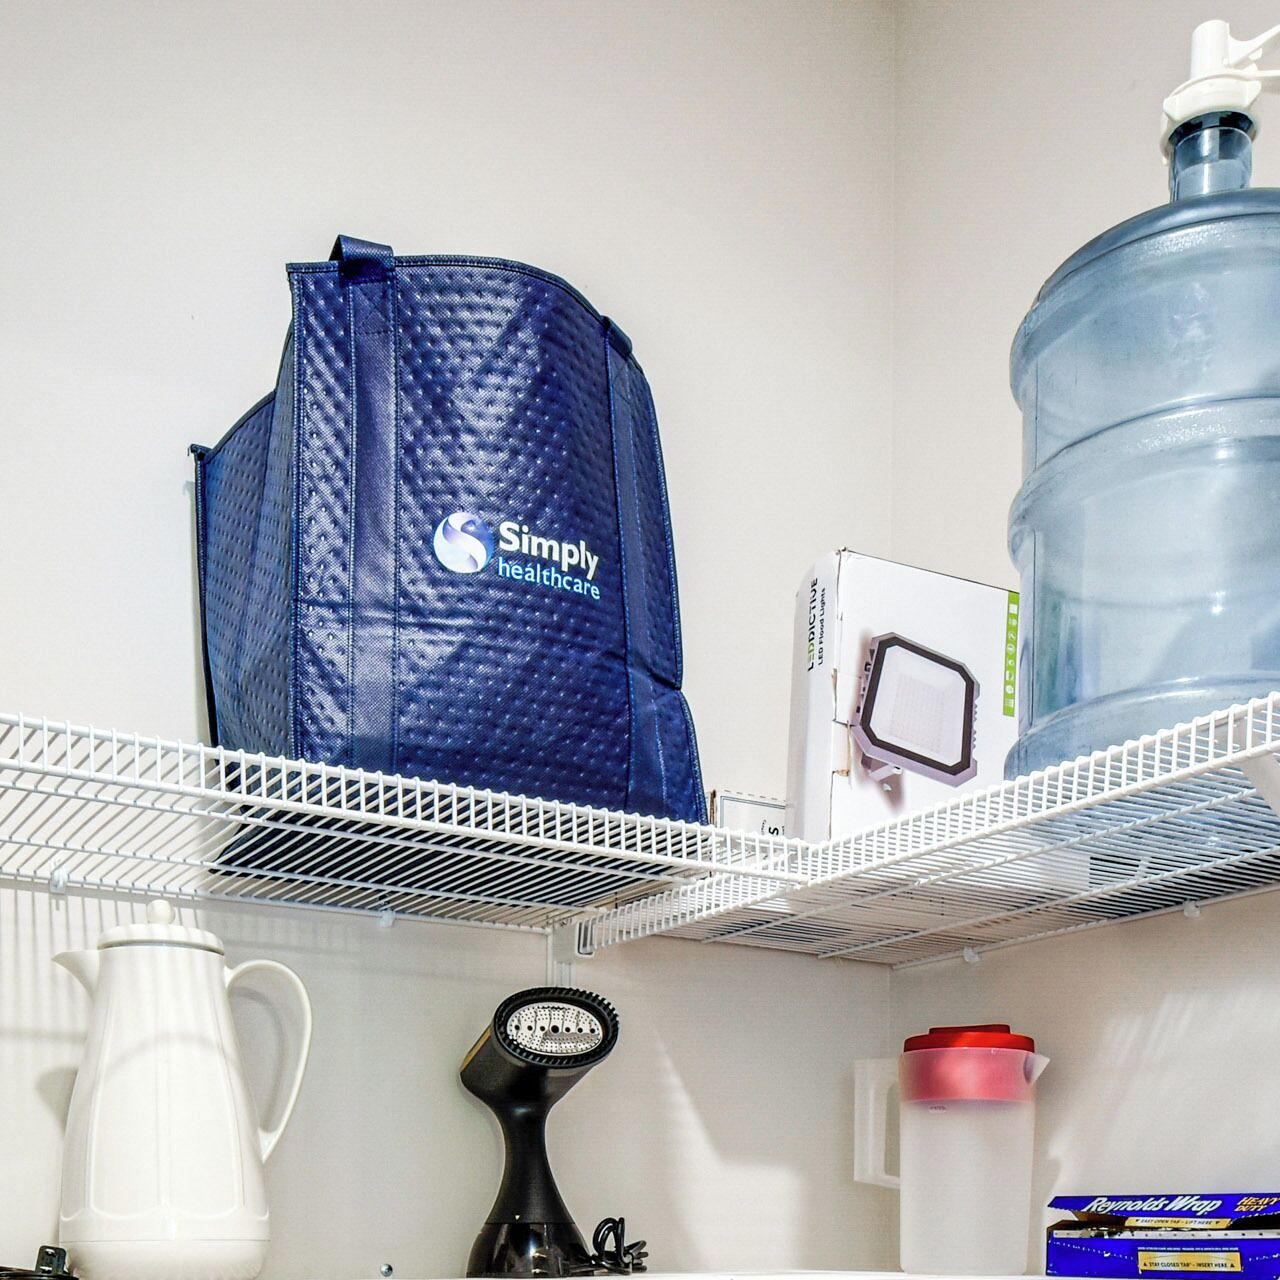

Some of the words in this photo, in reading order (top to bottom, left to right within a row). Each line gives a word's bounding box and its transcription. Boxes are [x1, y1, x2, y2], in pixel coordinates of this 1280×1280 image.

[498, 521, 599, 580] Simply
[497, 556, 601, 600] healthcare
[1080, 1196, 1169, 1214] Reynolds
[1164, 1195, 1223, 1215] Wrap
[1234, 1204, 1268, 1212] DUTY
